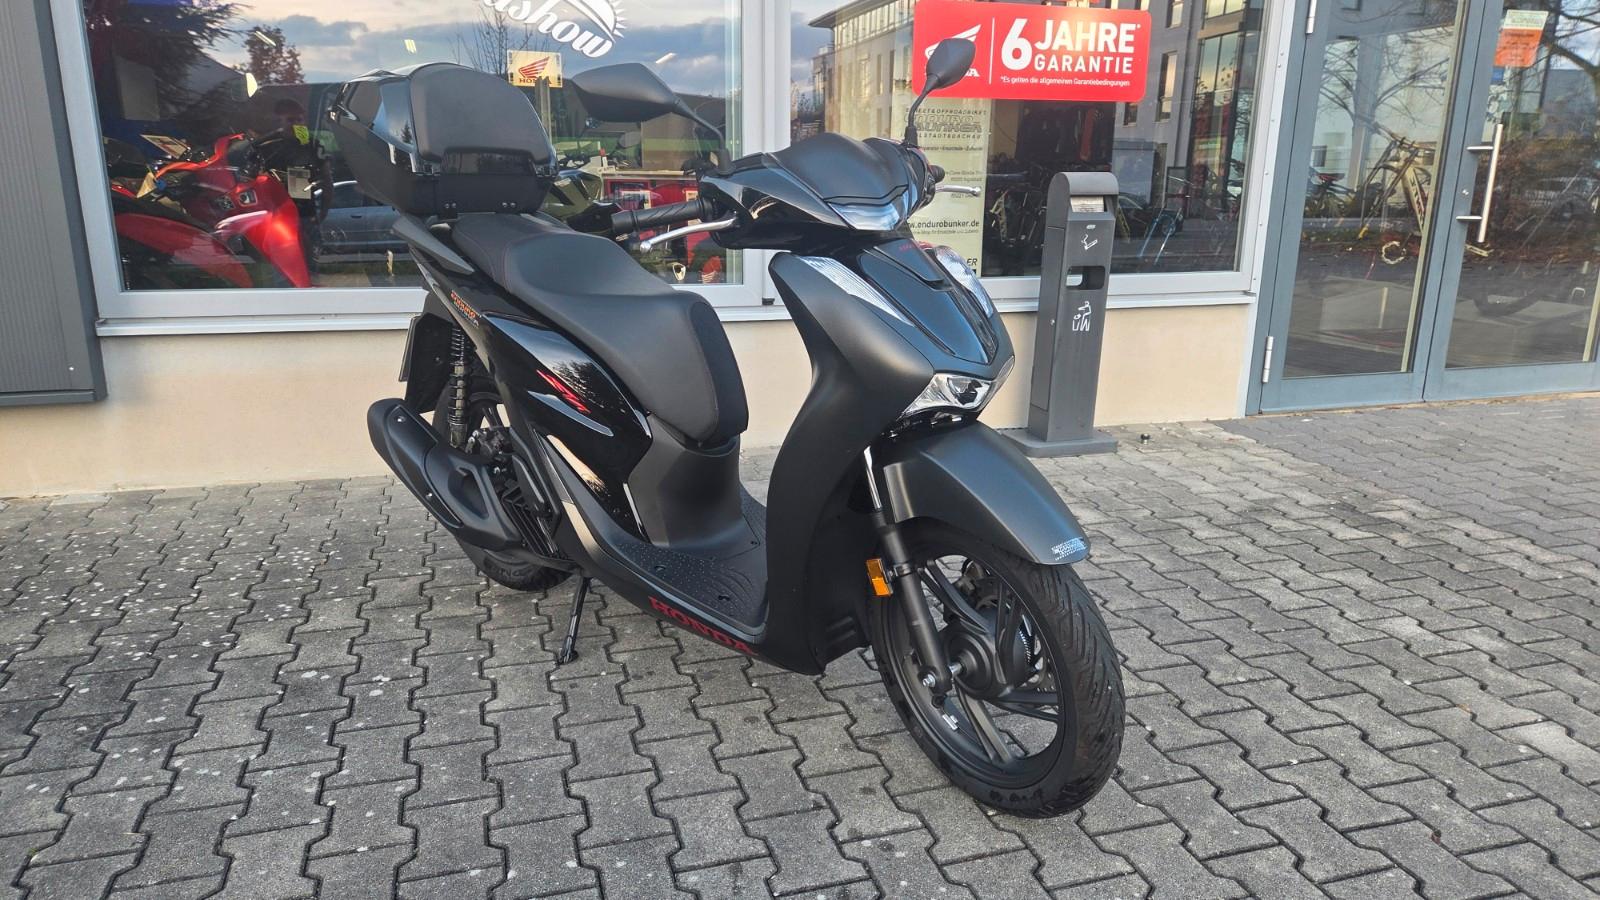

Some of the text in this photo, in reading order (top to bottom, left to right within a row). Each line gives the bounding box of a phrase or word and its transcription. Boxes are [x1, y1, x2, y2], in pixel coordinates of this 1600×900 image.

[1001, 18, 1033, 71] 6
[1034, 54, 1133, 74] GARANTIE
[1040, 78, 1073, 86] allgemeinen
[1074, 79, 1130, 88] Garantiebedingungen
[648, 596, 758, 656] HONDA
